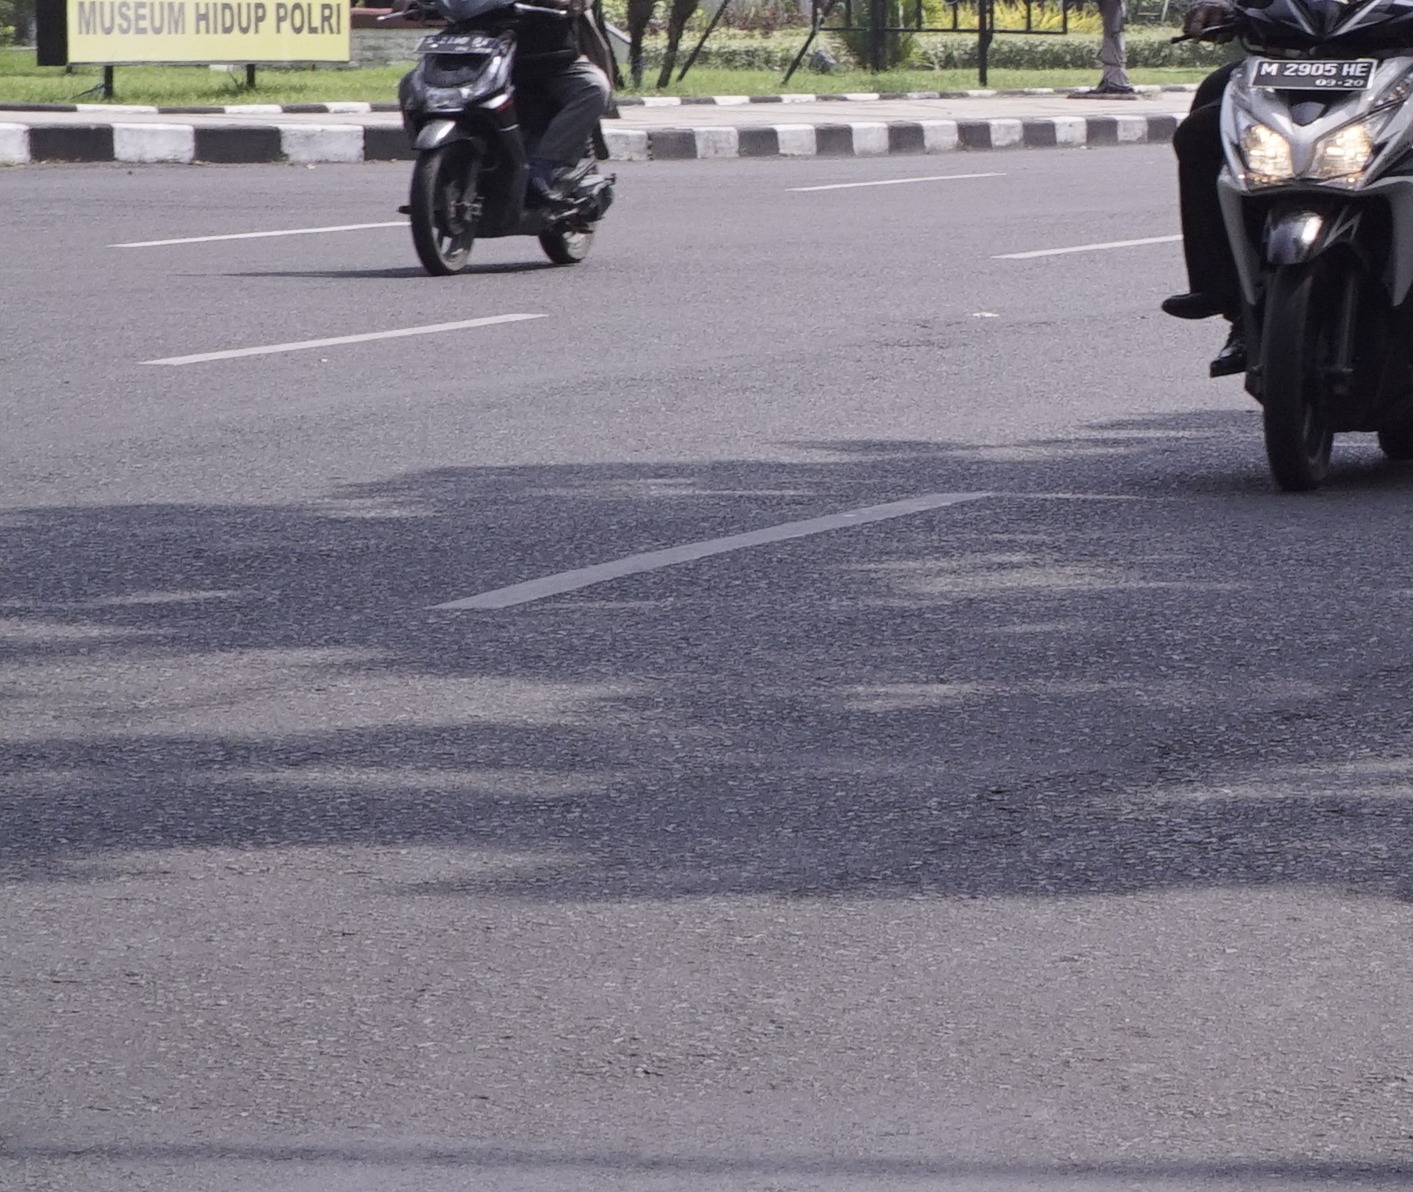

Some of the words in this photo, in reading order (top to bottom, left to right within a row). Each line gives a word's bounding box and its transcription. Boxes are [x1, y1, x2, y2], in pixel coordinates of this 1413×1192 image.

[77, 0, 186, 35] MUSEUM
[194, 2, 266, 35] HIDUP
[276, 2, 342, 35] POLRI
[1260, 62, 1279, 76] M
[1283, 63, 1338, 76] 2905
[1342, 63, 1368, 76] HE
